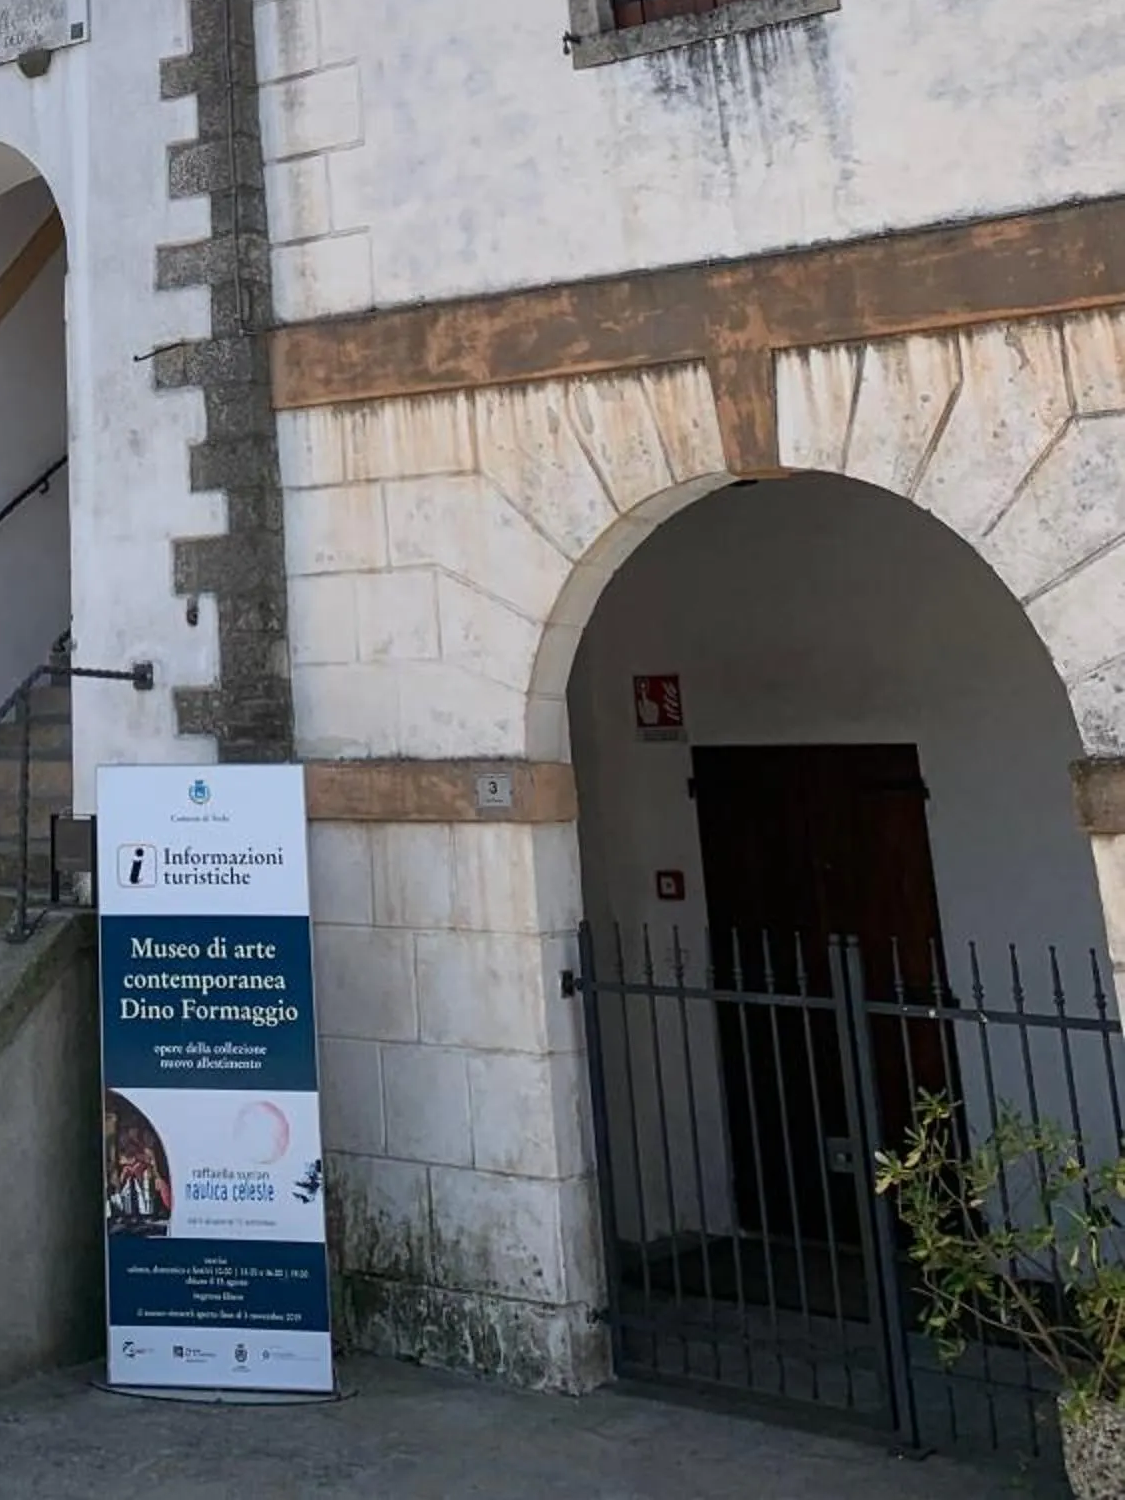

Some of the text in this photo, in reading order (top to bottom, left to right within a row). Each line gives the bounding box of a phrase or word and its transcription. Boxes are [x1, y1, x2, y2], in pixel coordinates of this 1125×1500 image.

[489, 781, 498, 795] 3
[163, 845, 283, 865] Informazioni
[163, 866, 251, 885] turistiche
[130, 936, 276, 959] Museo di arte
[123, 971, 286, 996] contemporanea
[120, 997, 299, 1027] Dino Formaggio
[154, 1041, 267, 1057] opere della collezione
[160, 1056, 262, 1070] nuovo allestimento
[185, 1181, 275, 1202] nautica celeste
